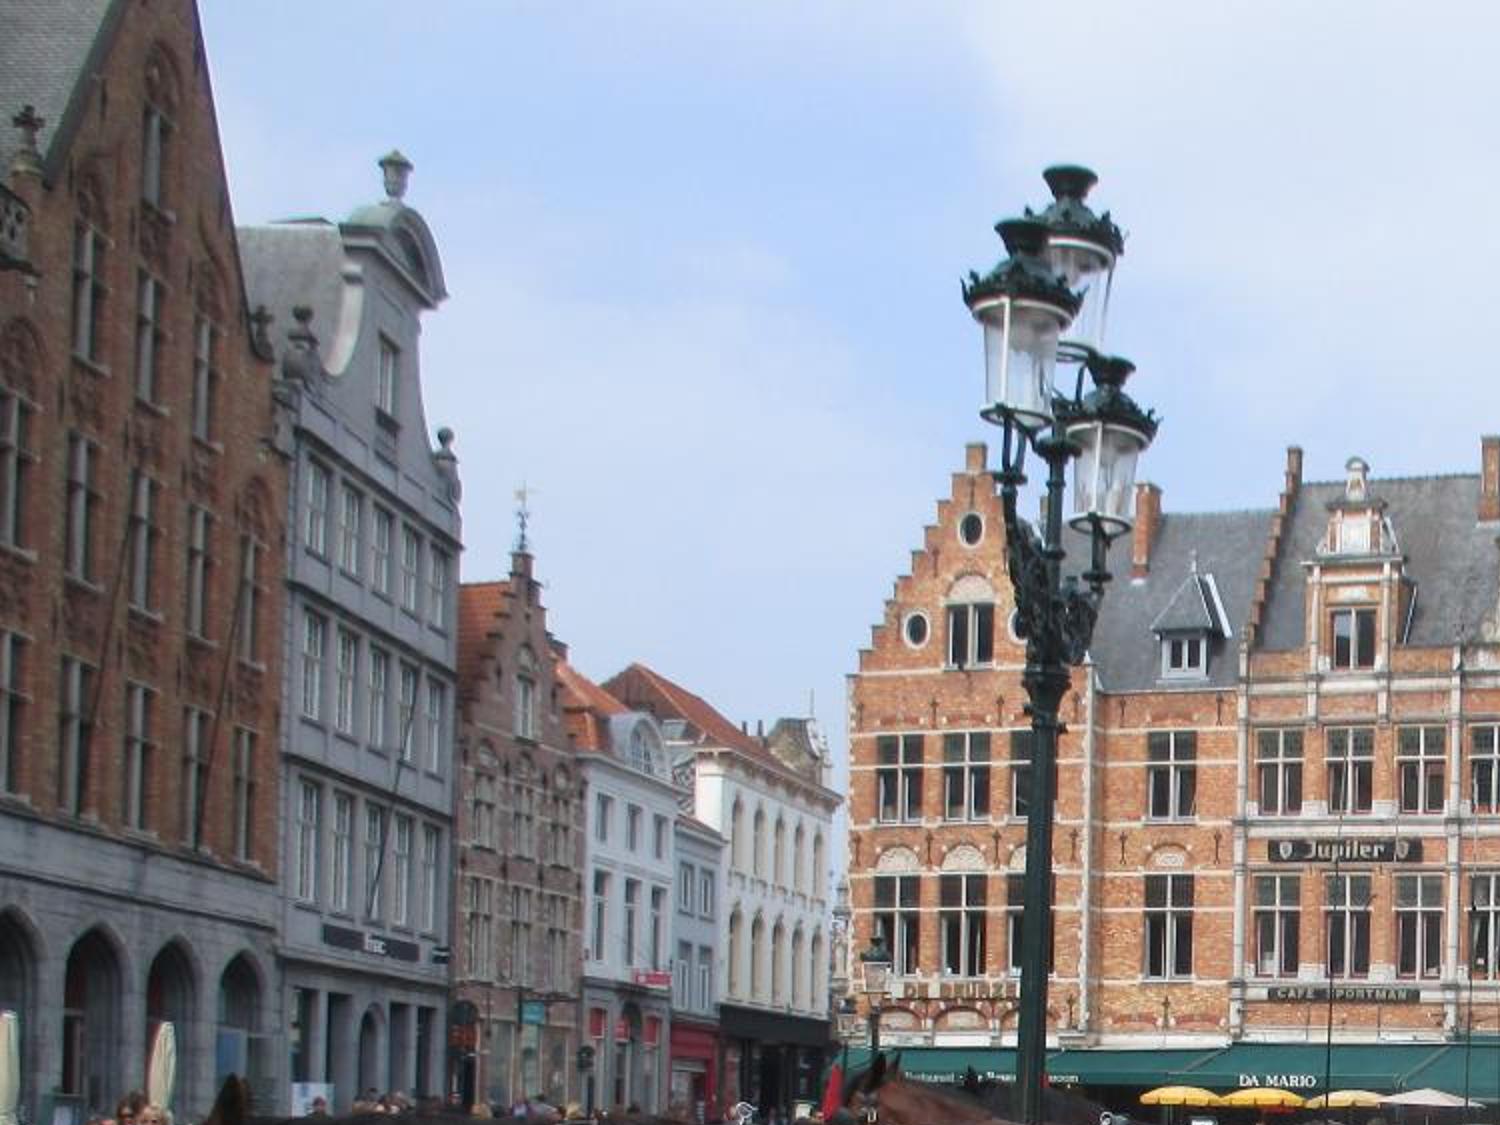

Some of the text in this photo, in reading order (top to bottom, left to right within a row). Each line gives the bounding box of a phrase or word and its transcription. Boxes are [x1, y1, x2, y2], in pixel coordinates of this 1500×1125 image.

[1304, 838, 1385, 863] Jupiler
[1239, 1074, 1317, 1088] DA MARIO
